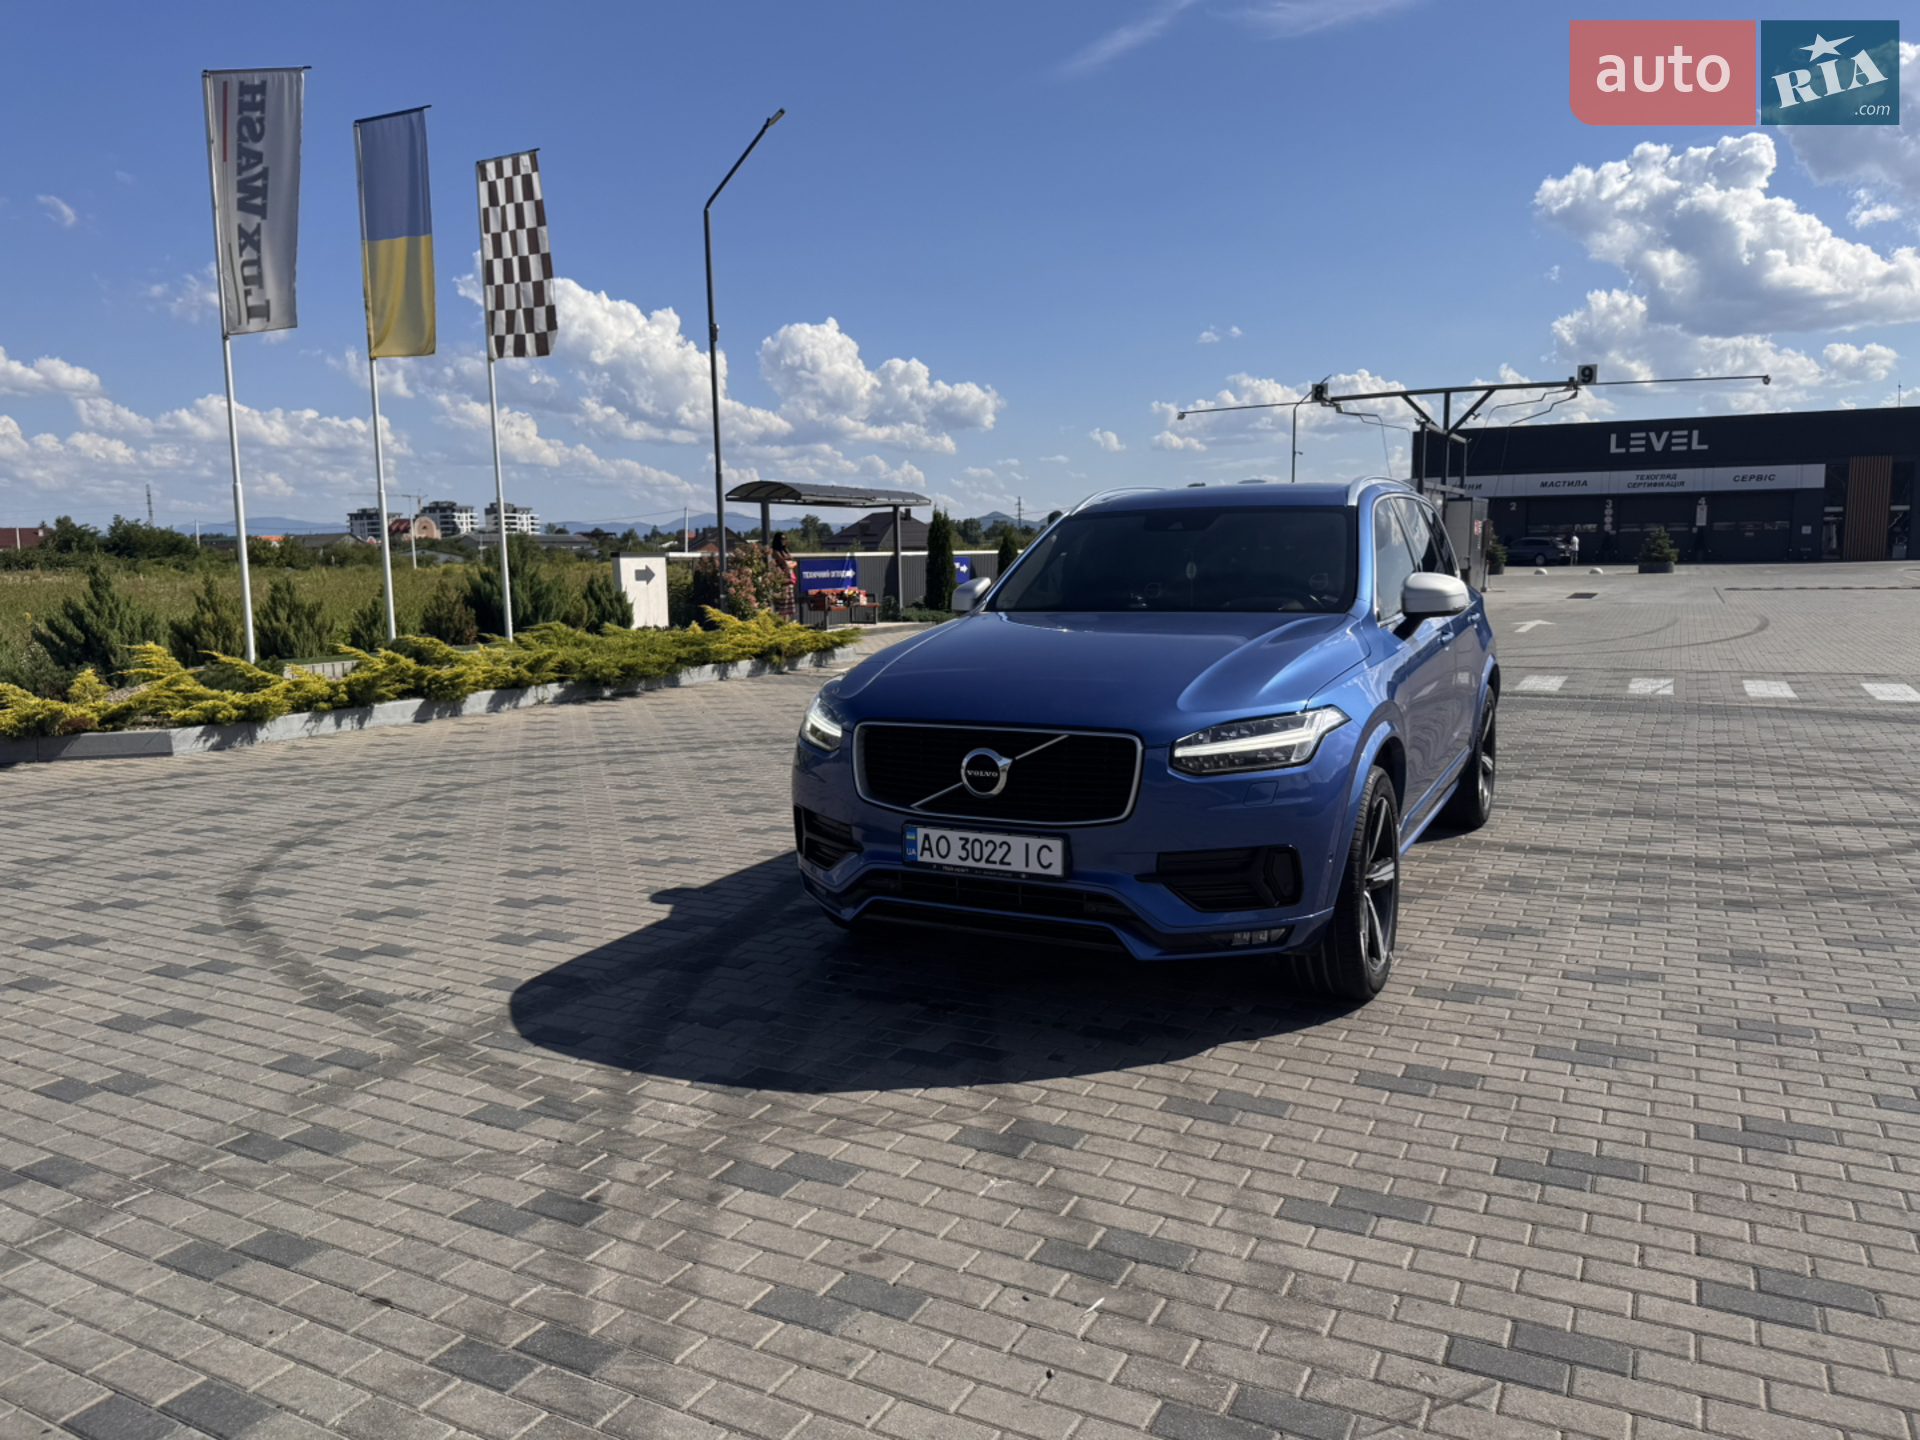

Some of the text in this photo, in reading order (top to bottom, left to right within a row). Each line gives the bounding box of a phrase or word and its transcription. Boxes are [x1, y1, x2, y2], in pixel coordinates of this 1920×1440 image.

[1581, 366, 1593, 383] 9
[1610, 430, 1708, 453] LEVEL
[1732, 473, 1776, 482] СЕРВІС
[1540, 479, 1588, 488] МАСТИЛА
[1627, 481, 1685, 489] СЕРТИФІКАЦІЯ
[1605, 499, 1613, 508] 3
[967, 769, 998, 777] VOLVO
[907, 847, 917, 856] UA
[920, 833, 951, 859] AO
[958, 836, 1012, 866] 3022
